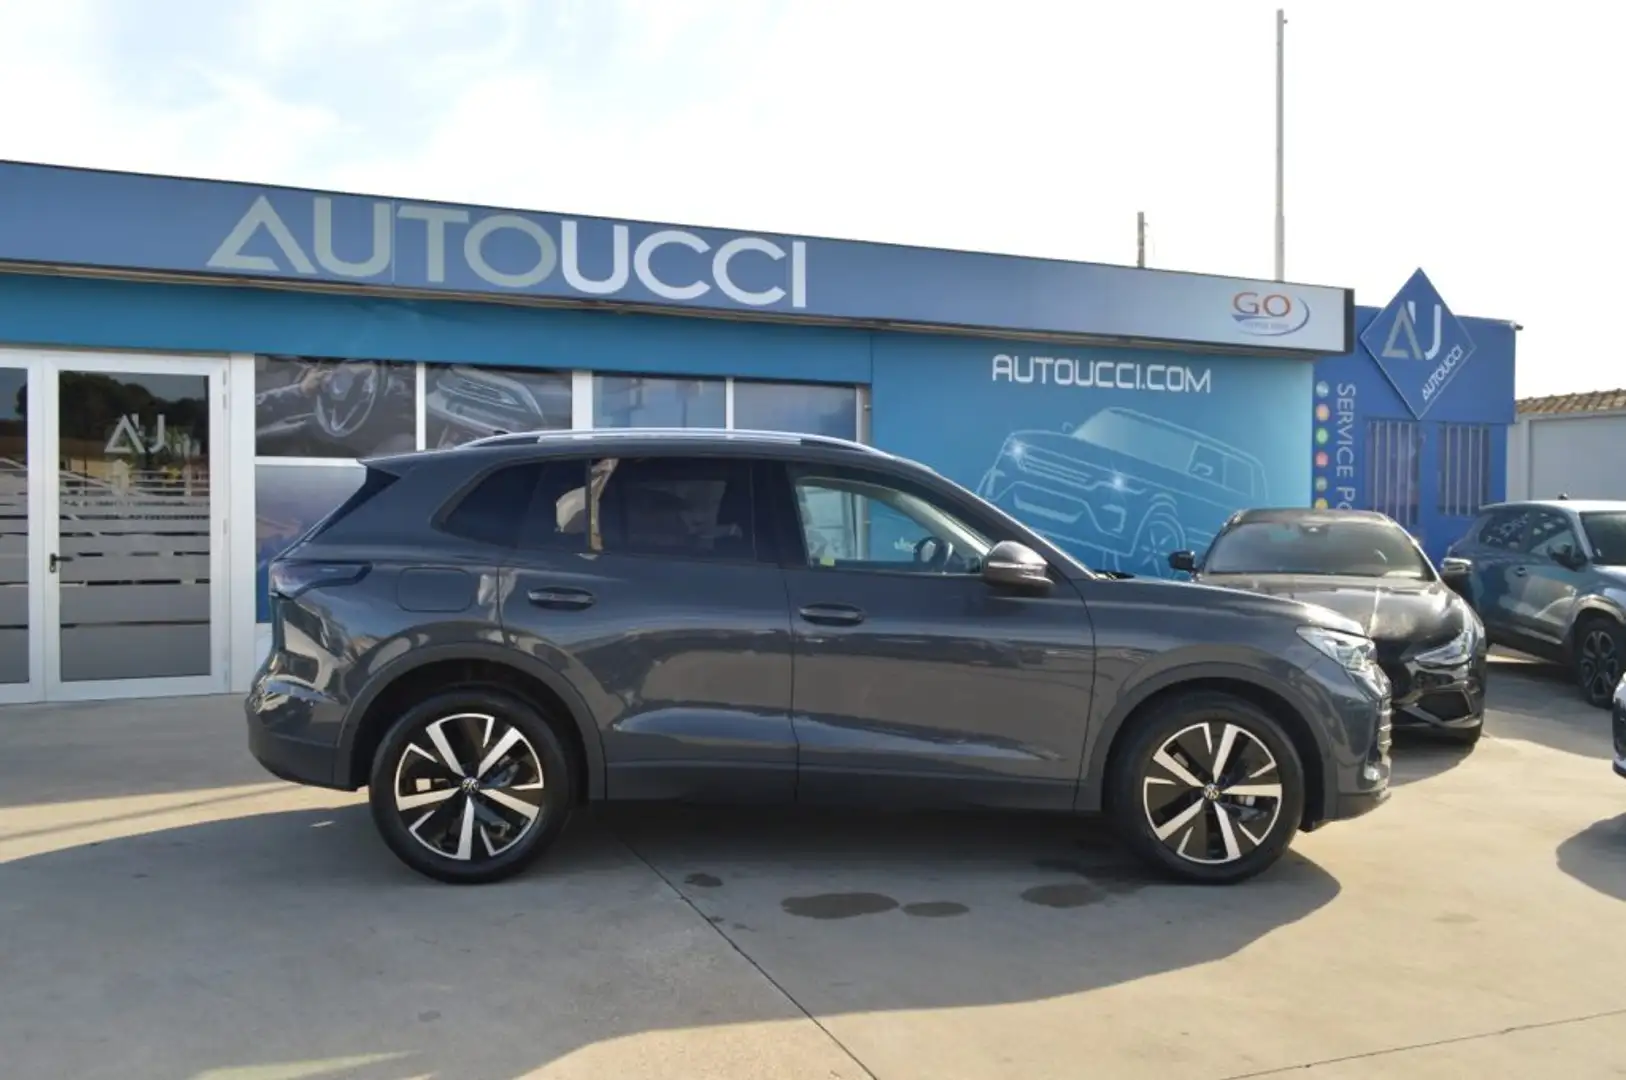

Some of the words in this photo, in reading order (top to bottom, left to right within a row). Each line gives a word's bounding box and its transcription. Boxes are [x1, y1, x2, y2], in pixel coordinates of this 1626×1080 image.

[206, 195, 807, 308] AUTOUCCI
[1233, 291, 1291, 318] GO
[991, 353, 1212, 394] AUTOUCCI.COM
[1422, 344, 1464, 401] AUTOUCCI
[1336, 382, 1356, 477] SERVICE
